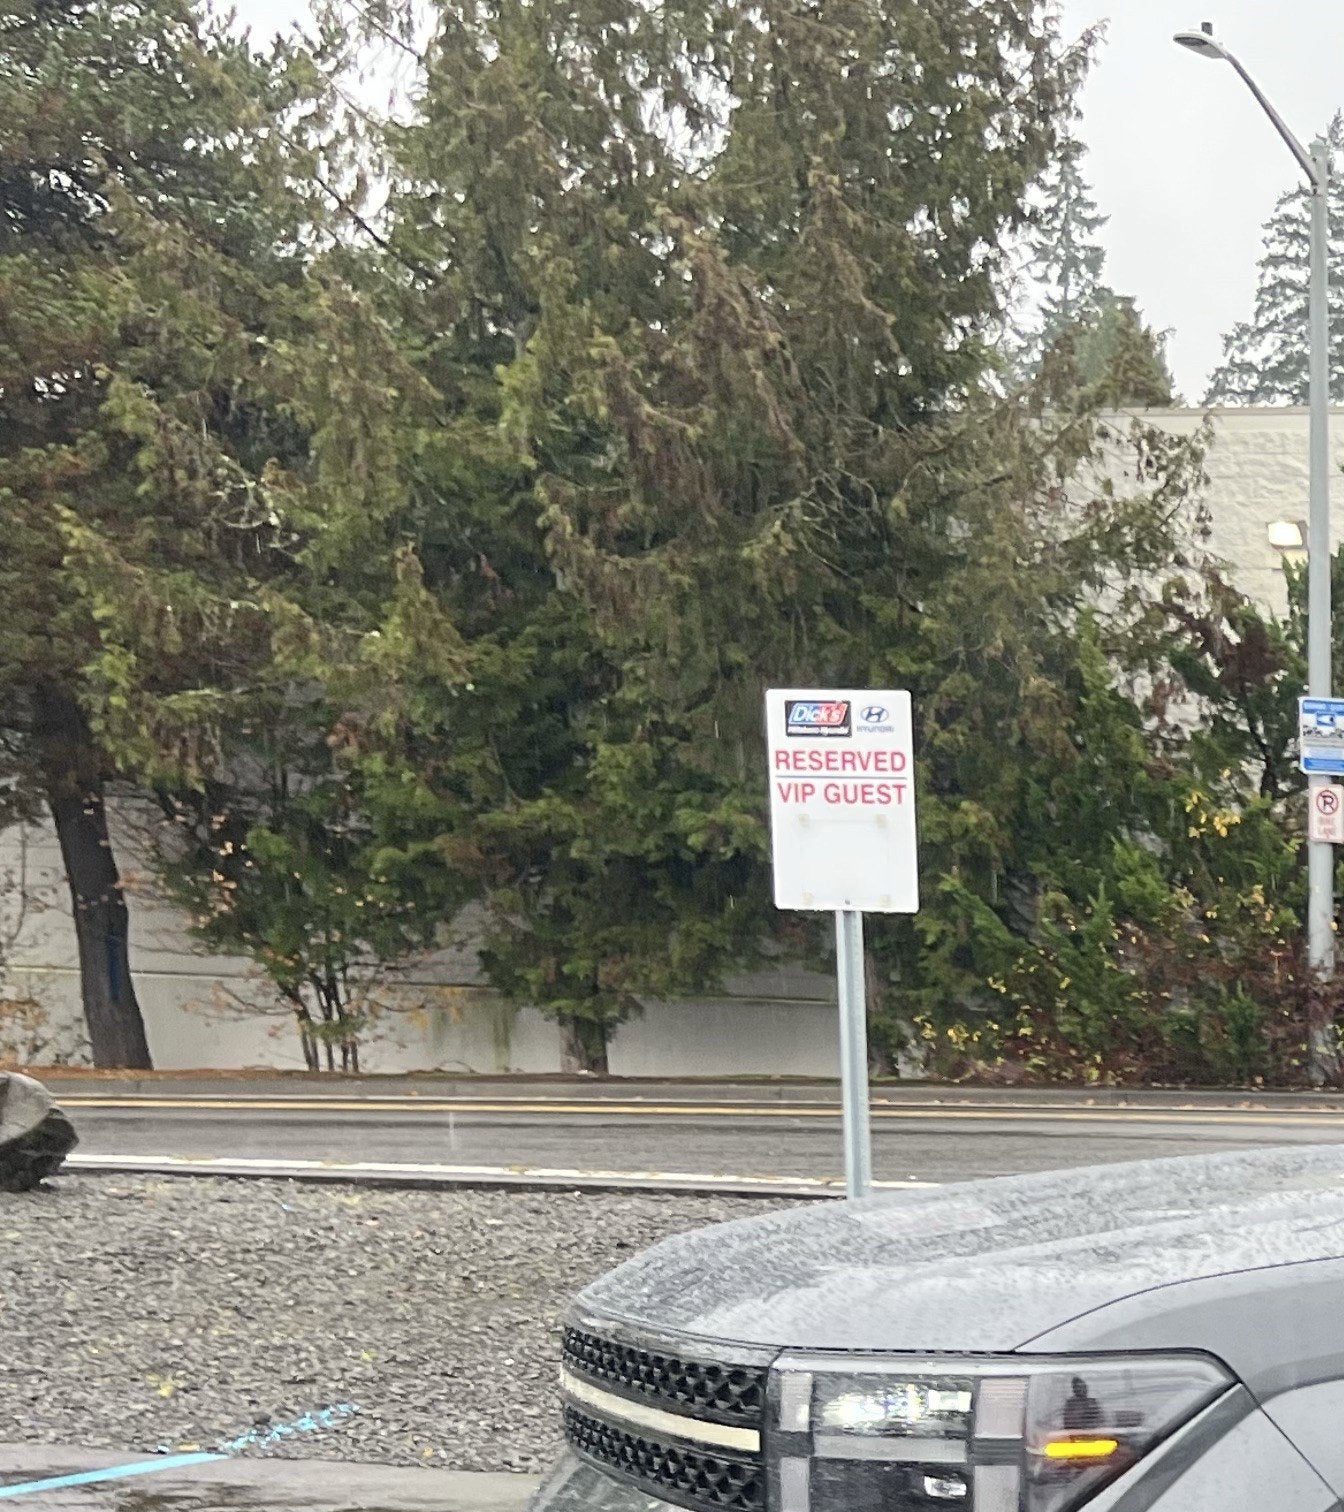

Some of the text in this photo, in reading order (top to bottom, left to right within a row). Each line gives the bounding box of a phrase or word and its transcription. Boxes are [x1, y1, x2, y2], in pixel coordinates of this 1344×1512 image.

[775, 750, 906, 772] RESERVED
[777, 783, 906, 804] VIP GUEST
